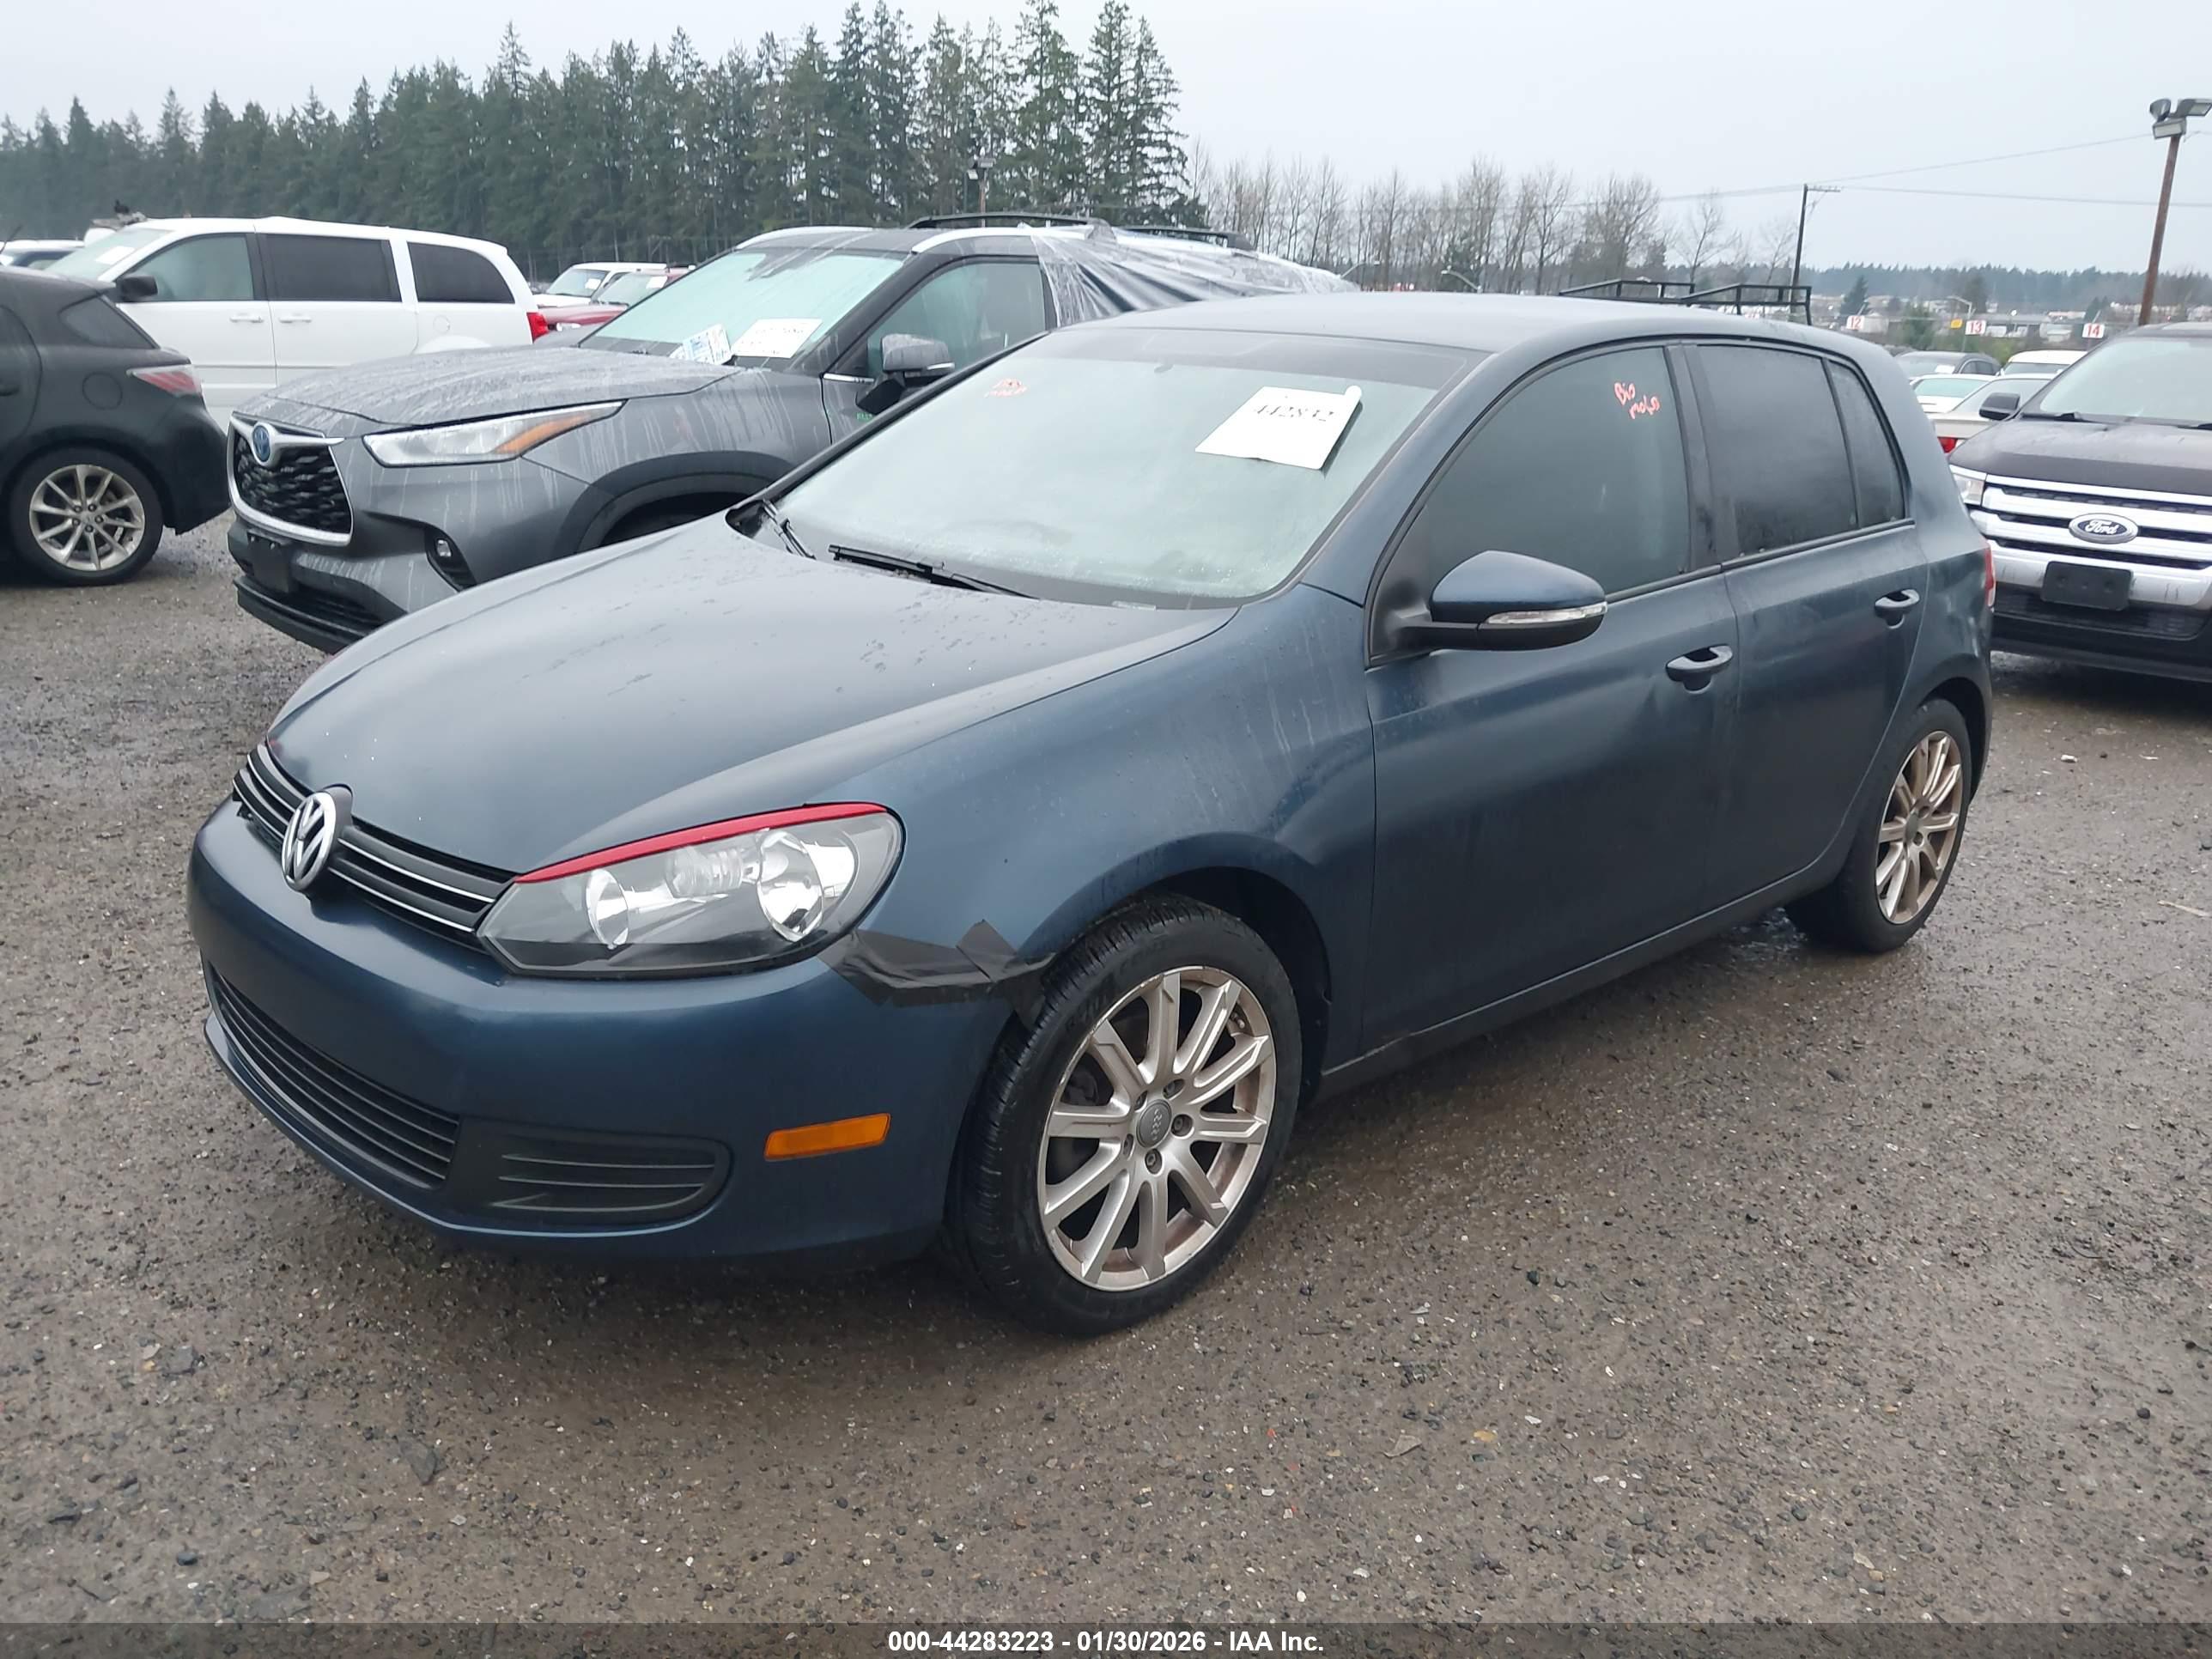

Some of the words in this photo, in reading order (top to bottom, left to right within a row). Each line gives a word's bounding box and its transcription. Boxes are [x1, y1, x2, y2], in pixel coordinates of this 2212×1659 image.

[1850, 316, 1862, 329] 12
[1971, 320, 1982, 333] 13
[2087, 324, 2100, 337] 14
[2085, 519, 2120, 535] Ford
